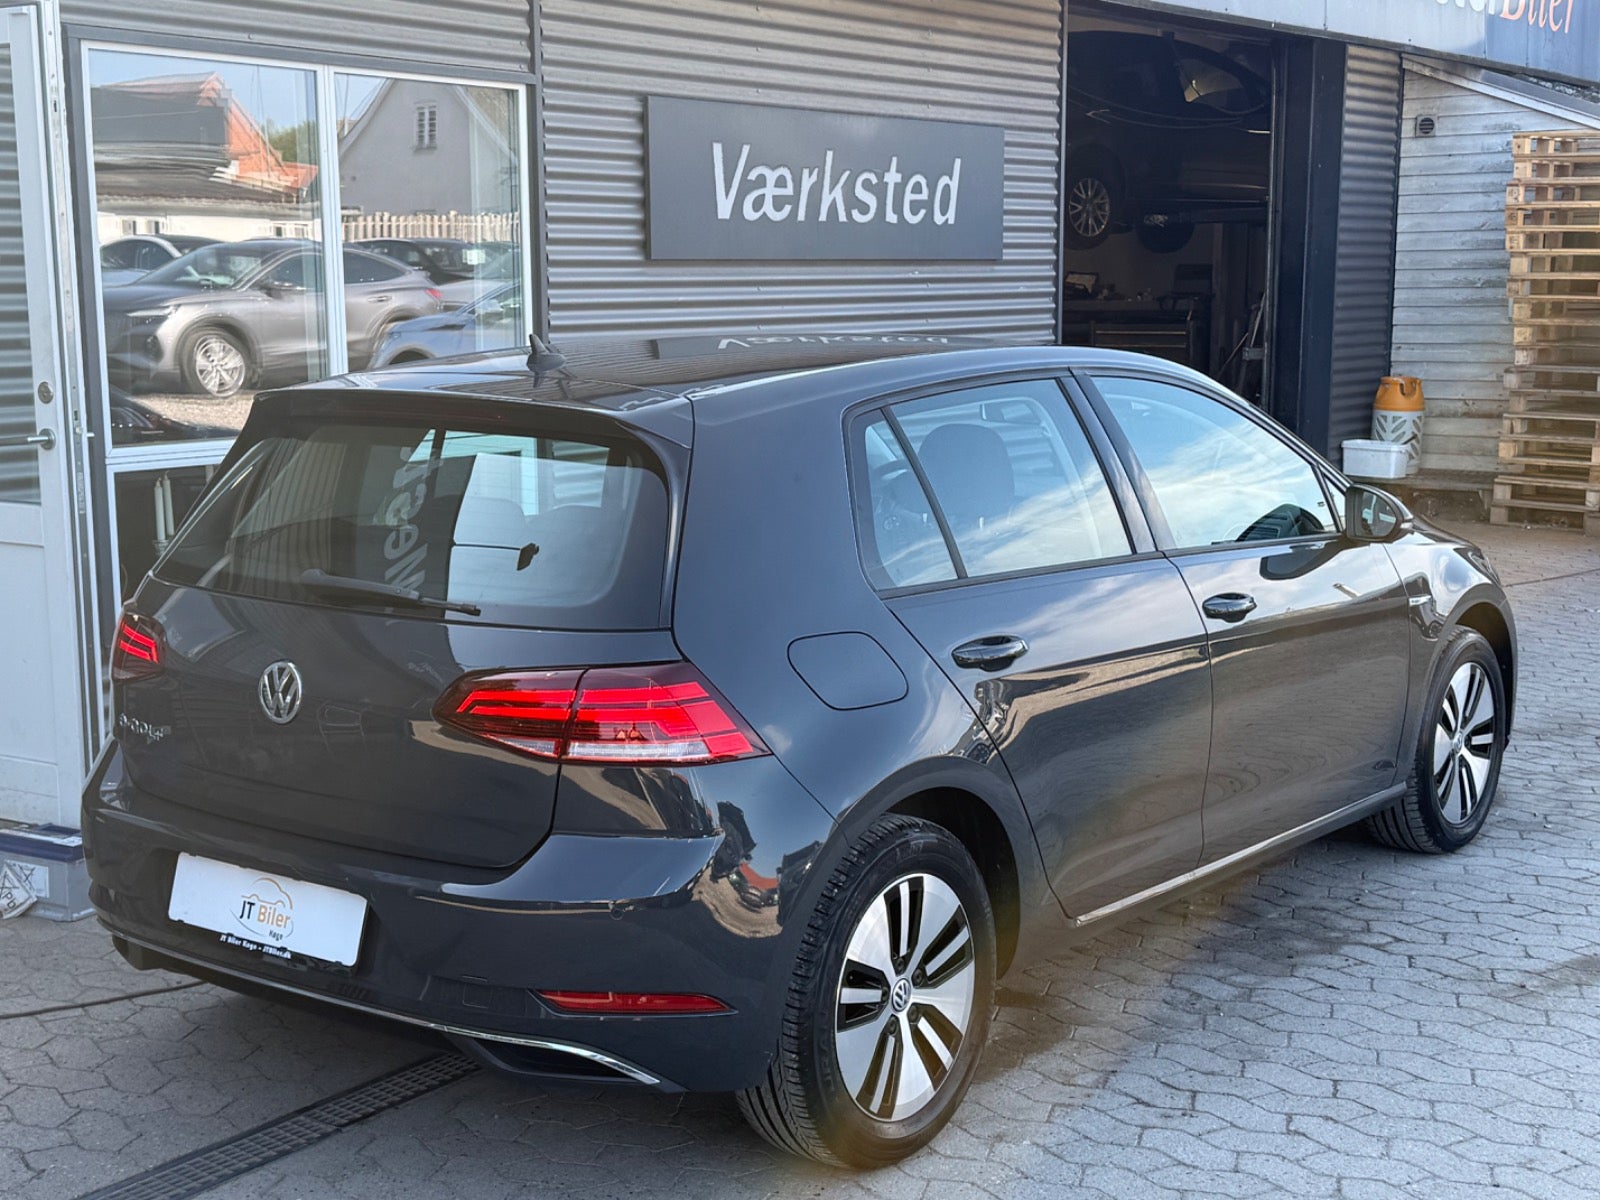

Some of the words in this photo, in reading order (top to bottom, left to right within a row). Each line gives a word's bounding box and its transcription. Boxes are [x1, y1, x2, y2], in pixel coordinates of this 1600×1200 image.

[712, 142, 961, 226] Værksted
[239, 900, 256, 920] JT
[257, 904, 291, 928] Biler
